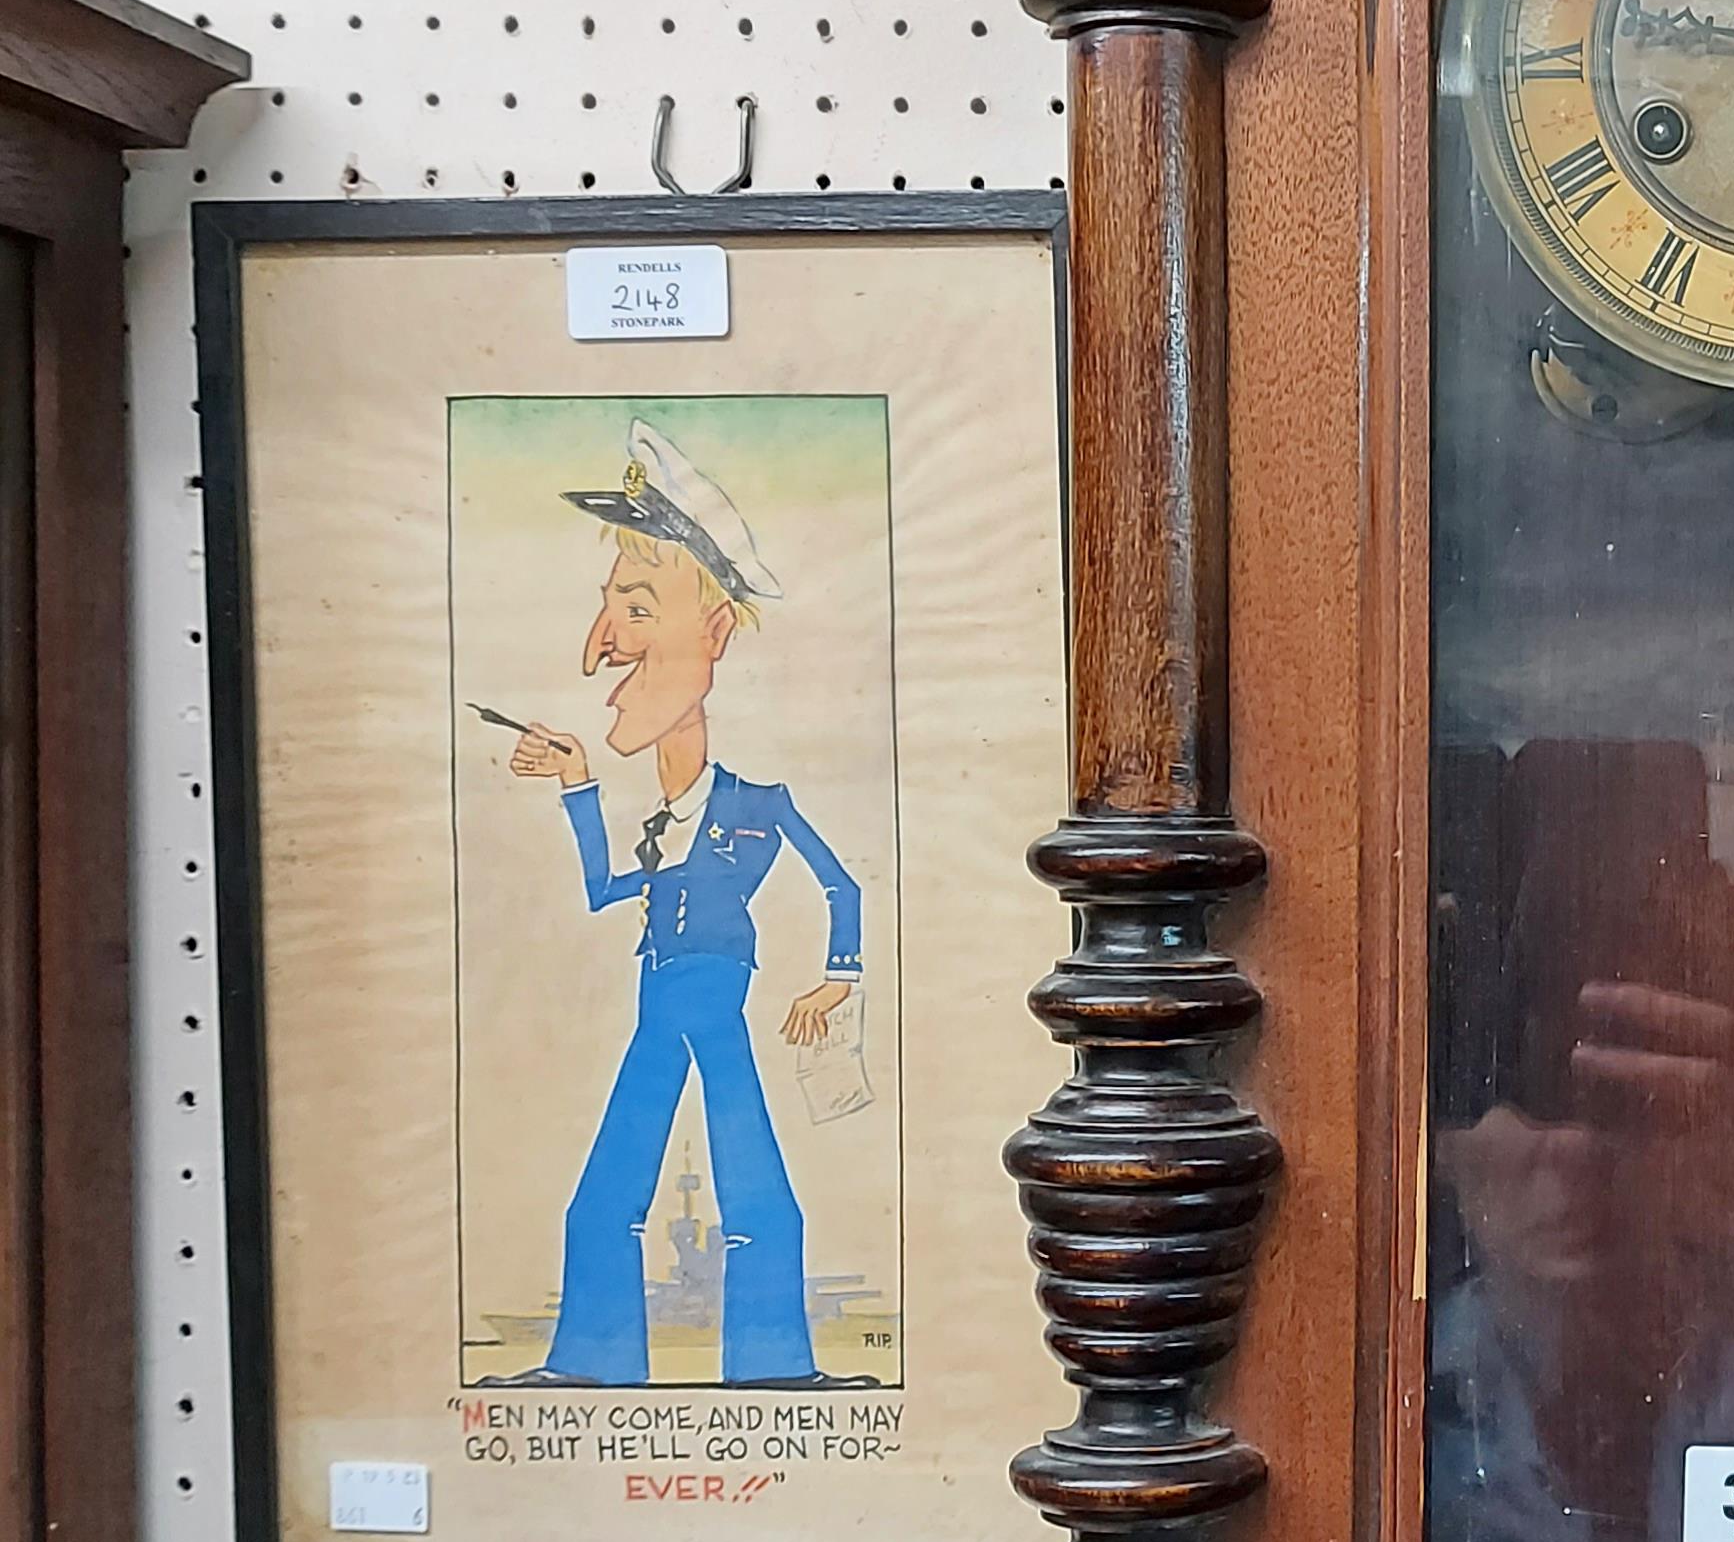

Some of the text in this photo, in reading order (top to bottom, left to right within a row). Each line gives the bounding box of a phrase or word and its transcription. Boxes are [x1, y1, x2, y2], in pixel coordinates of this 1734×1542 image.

[618, 262, 682, 273] RENDELLS
[1635, 227, 1700, 308] VII
[612, 283, 680, 311] 2148
[611, 317, 685, 328] STONEPARK
[538, 1404, 599, 1429] MAY
[774, 1404, 834, 1431] MEN
[851, 1403, 904, 1432] MAY
[465, 1436, 516, 1465] GO,
[527, 1436, 582, 1461] BUT
[599, 1435, 692, 1462] HE'LL
[706, 1437, 748, 1460] GO
[763, 1435, 808, 1460] ON
